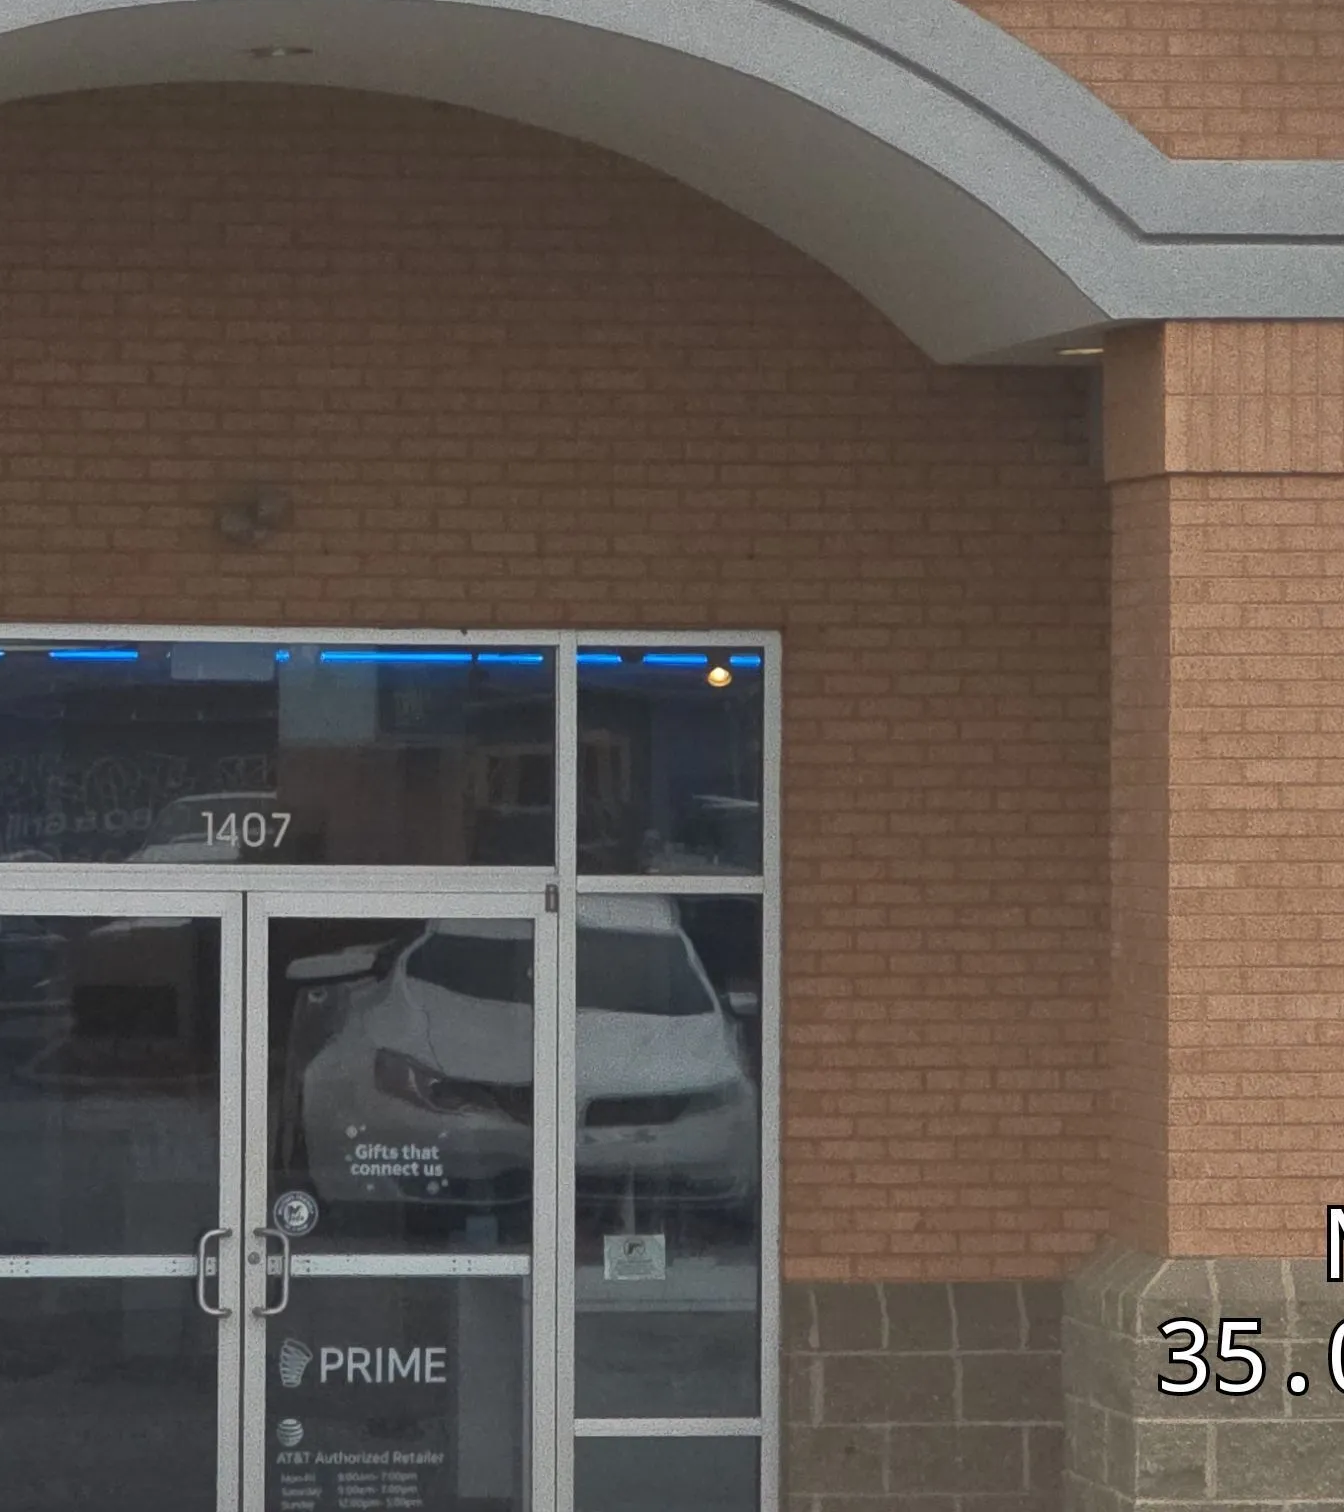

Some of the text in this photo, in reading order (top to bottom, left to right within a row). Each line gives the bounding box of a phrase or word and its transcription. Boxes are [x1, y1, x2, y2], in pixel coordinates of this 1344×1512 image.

[201, 811, 292, 848] 1407
[355, 1144, 440, 1160] Gifts that
[350, 1162, 444, 1176] connect us
[320, 1347, 447, 1383] PRIME
[276, 1449, 445, 1465] AT&T Authorized Retailer
